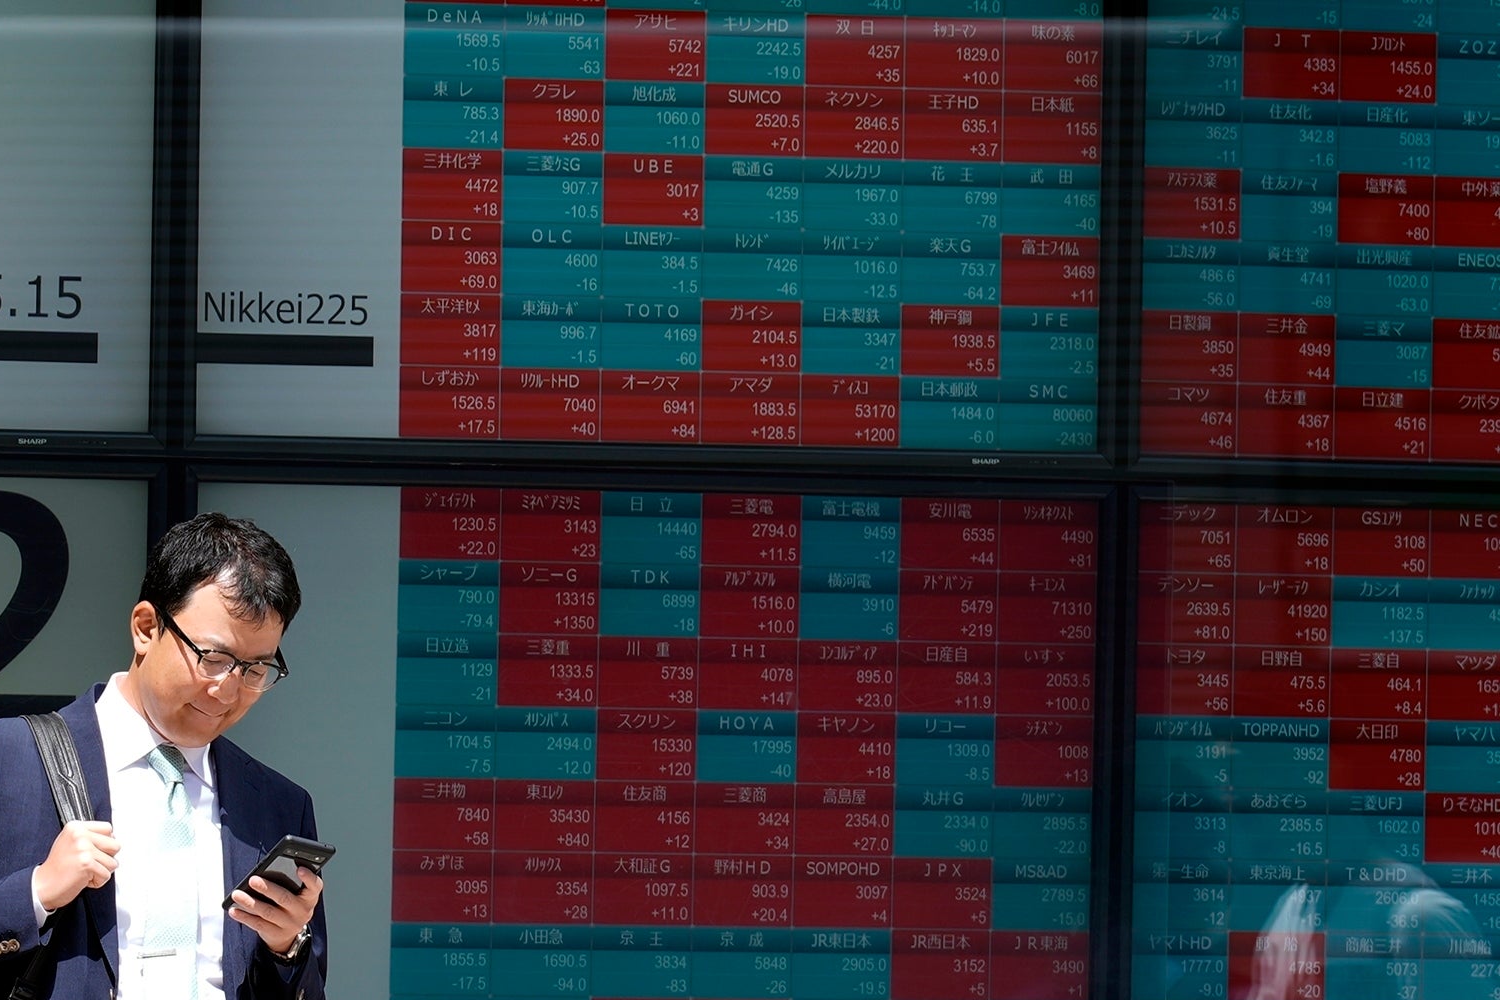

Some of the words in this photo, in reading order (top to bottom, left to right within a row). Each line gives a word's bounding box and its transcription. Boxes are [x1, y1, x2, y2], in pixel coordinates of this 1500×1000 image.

[633, 14, 677, 31] アサヒ
[1031, 24, 1075, 41] 味の素
[668, 38, 702, 54] 5742
[867, 44, 901, 59] 4257
[956, 47, 1000, 62] 1829.0
[1065, 49, 1099, 65] 6017
[668, 63, 700, 77] +221
[1303, 57, 1336, 73] 4383
[875, 68, 901, 83] +35
[962, 70, 1000, 86] +10.0
[1073, 73, 1098, 88] +66
[532, 84, 577, 100] クラレ
[632, 86, 677, 103] 旭化成
[1312, 82, 1335, 95] +34
[728, 89, 782, 105] SUMCO
[825, 90, 883, 108] ネクソン
[929, 94, 979, 110] 王子HD
[1031, 96, 1075, 113] 日本紙
[555, 108, 600, 123] 1890.0
[656, 110, 701, 126] 1060.0
[1269, 103, 1312, 120] 住友化
[755, 113, 800, 129] 2520.5
[854, 115, 900, 131] 2846.5
[961, 118, 997, 134] 635.1
[1066, 121, 1098, 137] 1155
[562, 132, 600, 147] +25.0
[1299, 128, 1334, 144] 342.8
[771, 137, 800, 152] +7.0
[854, 139, 900, 155] +220.0
[969, 142, 998, 157] +3.7
[1080, 145, 1098, 160] +8
[423, 153, 482, 170] 三井化学
[1309, 152, 1334, 167] -1.6
[824, 163, 881, 180] メルカリ
[464, 178, 499, 193] 4472
[1364, 177, 1407, 195] 塩野義
[855, 188, 899, 203] 1967.0
[1398, 202, 1430, 218] 7400
[864, 211, 898, 226] -33.0
[1405, 227, 1430, 241] +80
[960, 262, 996, 277] 753.7
[963, 286, 996, 301] -64.2
[203, 290, 369, 326] Nikkei225
[729, 304, 774, 321] ガイシ
[823, 307, 881, 324] 日本製鉄
[928, 308, 973, 326] 神戸鋼
[1169, 315, 1212, 332] 日製鋼
[752, 329, 797, 345] 2104.5
[864, 332, 897, 347] 3347
[952, 334, 996, 349] 1938.5
[1202, 339, 1234, 354] 3850
[759, 353, 797, 368] +13.0
[875, 355, 895, 371] -21
[966, 357, 996, 373] +5.5
[421, 369, 480, 386] しずおか
[1209, 363, 1234, 378] +35
[621, 373, 680, 391] オークマ
[729, 376, 773, 393] アマダ
[921, 381, 978, 398] 日本郵政
[1169, 387, 1210, 402] コマツ
[1264, 389, 1307, 406] 住友重
[1362, 392, 1404, 409] 日立建
[451, 395, 496, 411] 1526.5
[663, 399, 695, 415] 6941
[752, 401, 797, 417] 1883.5
[951, 406, 995, 421] 1484.0
[1200, 411, 1233, 426] 4674
[1297, 414, 1330, 429] 4367
[458, 419, 496, 434] +17.5
[671, 423, 696, 438] +84
[1394, 416, 1427, 431] 4516
[750, 425, 796, 440] +128.5
[17, 437, 48, 445] SHARP
[1306, 438, 1329, 451] +18
[1402, 440, 1426, 454] +21
[730, 498, 774, 515] 三菱電
[928, 502, 973, 520] 安川電
[1256, 507, 1313, 524] オムロン
[751, 523, 797, 539] 2794.0
[962, 527, 995, 543] 6535
[1297, 532, 1329, 548] 5696
[759, 547, 797, 562] +11.5
[969, 551, 995, 566] +44
[1304, 557, 1329, 570] +18
[420, 564, 478, 581] シャープ
[1159, 576, 1214, 594] デンソー
[458, 589, 495, 604] 790.0
[555, 591, 596, 607] 13315
[1186, 601, 1231, 617] 2639.5
[460, 613, 494, 628] -79.4
[553, 615, 595, 630] +1350
[1193, 624, 1230, 640] +81.0
[526, 638, 570, 656] 三菱重
[926, 645, 968, 663] 日産自
[1166, 648, 1206, 665] トヨタ
[1261, 650, 1302, 667] 日野自
[549, 663, 594, 679] 1333.5
[955, 671, 992, 686] 584.3
[1197, 673, 1229, 688] 3445
[1289, 675, 1326, 690] 475.5
[556, 687, 594, 703] +34.0
[954, 695, 992, 710] +11.9
[1297, 698, 1326, 714] +5.6
[617, 713, 676, 730] スクリン
[818, 715, 875, 733] キヤノン
[1242, 722, 1320, 738] TOPPANHD
[1356, 724, 1399, 740] 大日印
[652, 738, 693, 753] 15330
[858, 742, 892, 756] 4410
[1293, 746, 1325, 761] 3952
[1389, 748, 1422, 763] 4780
[658, 761, 692, 777] +120
[866, 765, 891, 780] +18
[1303, 770, 1324, 785] -92
[1397, 772, 1421, 786] +28
[422, 781, 466, 799] 三井物
[622, 784, 667, 802] 住友商
[823, 787, 866, 805] 高島屋
[1250, 792, 1307, 809] あおぞら
[457, 807, 490, 822] 7840
[657, 810, 691, 825] 4156
[845, 813, 890, 828] 2354.0
[1279, 817, 1324, 833] 2385.5
[464, 831, 489, 846] +58
[665, 834, 690, 849] +12
[852, 836, 889, 852] +27.0
[1290, 841, 1323, 856] -16.5
[419, 854, 464, 871] みずほ
[806, 861, 880, 876] SOMPOHD
[455, 879, 488, 895] 3095
[855, 885, 888, 900] 3097
[462, 903, 488, 919] +13
[871, 909, 888, 923] +4
[519, 927, 564, 945] 小田急
[910, 933, 971, 950] JR西日本
[543, 953, 587, 968] 1690.5
[953, 958, 986, 973] 3152
[553, 977, 587, 992] -94.0
[968, 982, 986, 997] +5
